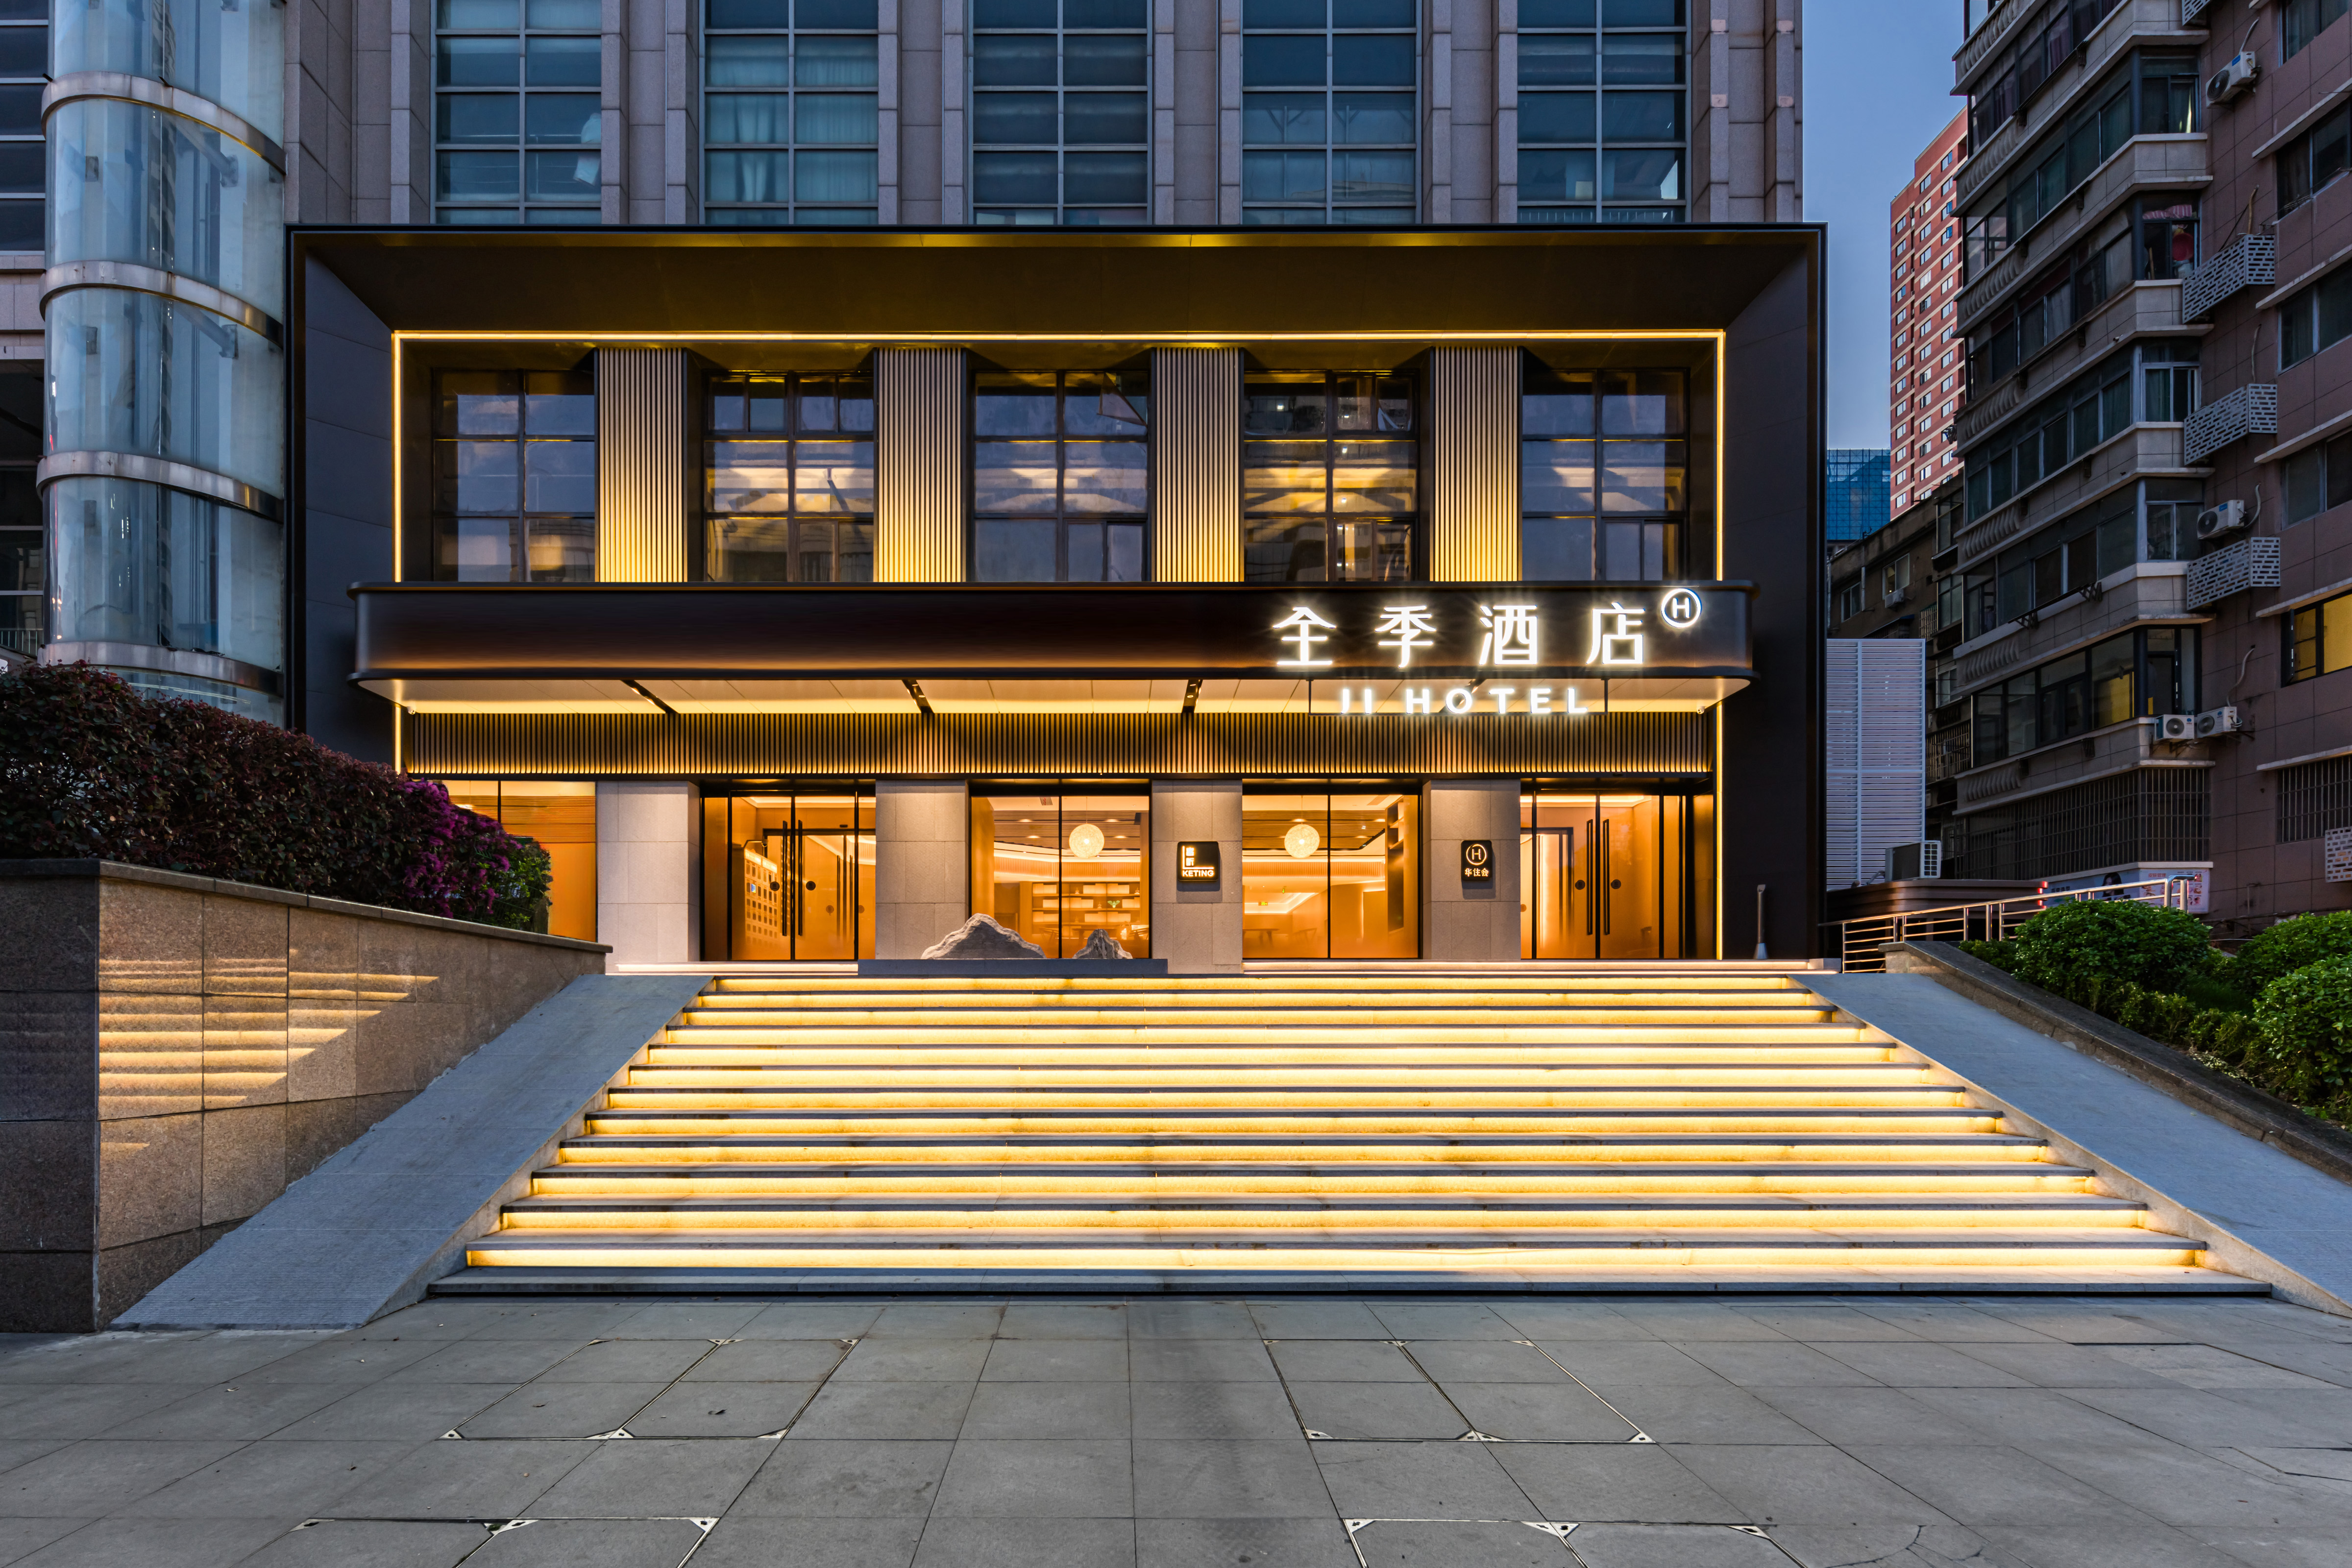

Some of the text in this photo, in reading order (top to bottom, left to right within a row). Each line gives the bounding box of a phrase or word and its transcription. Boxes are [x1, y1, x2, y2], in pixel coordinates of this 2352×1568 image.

[1272, 602, 1645, 667] 全季酒店
[1340, 688, 1588, 714] JI HOTEL
[1465, 867, 1489, 877] 华住会
